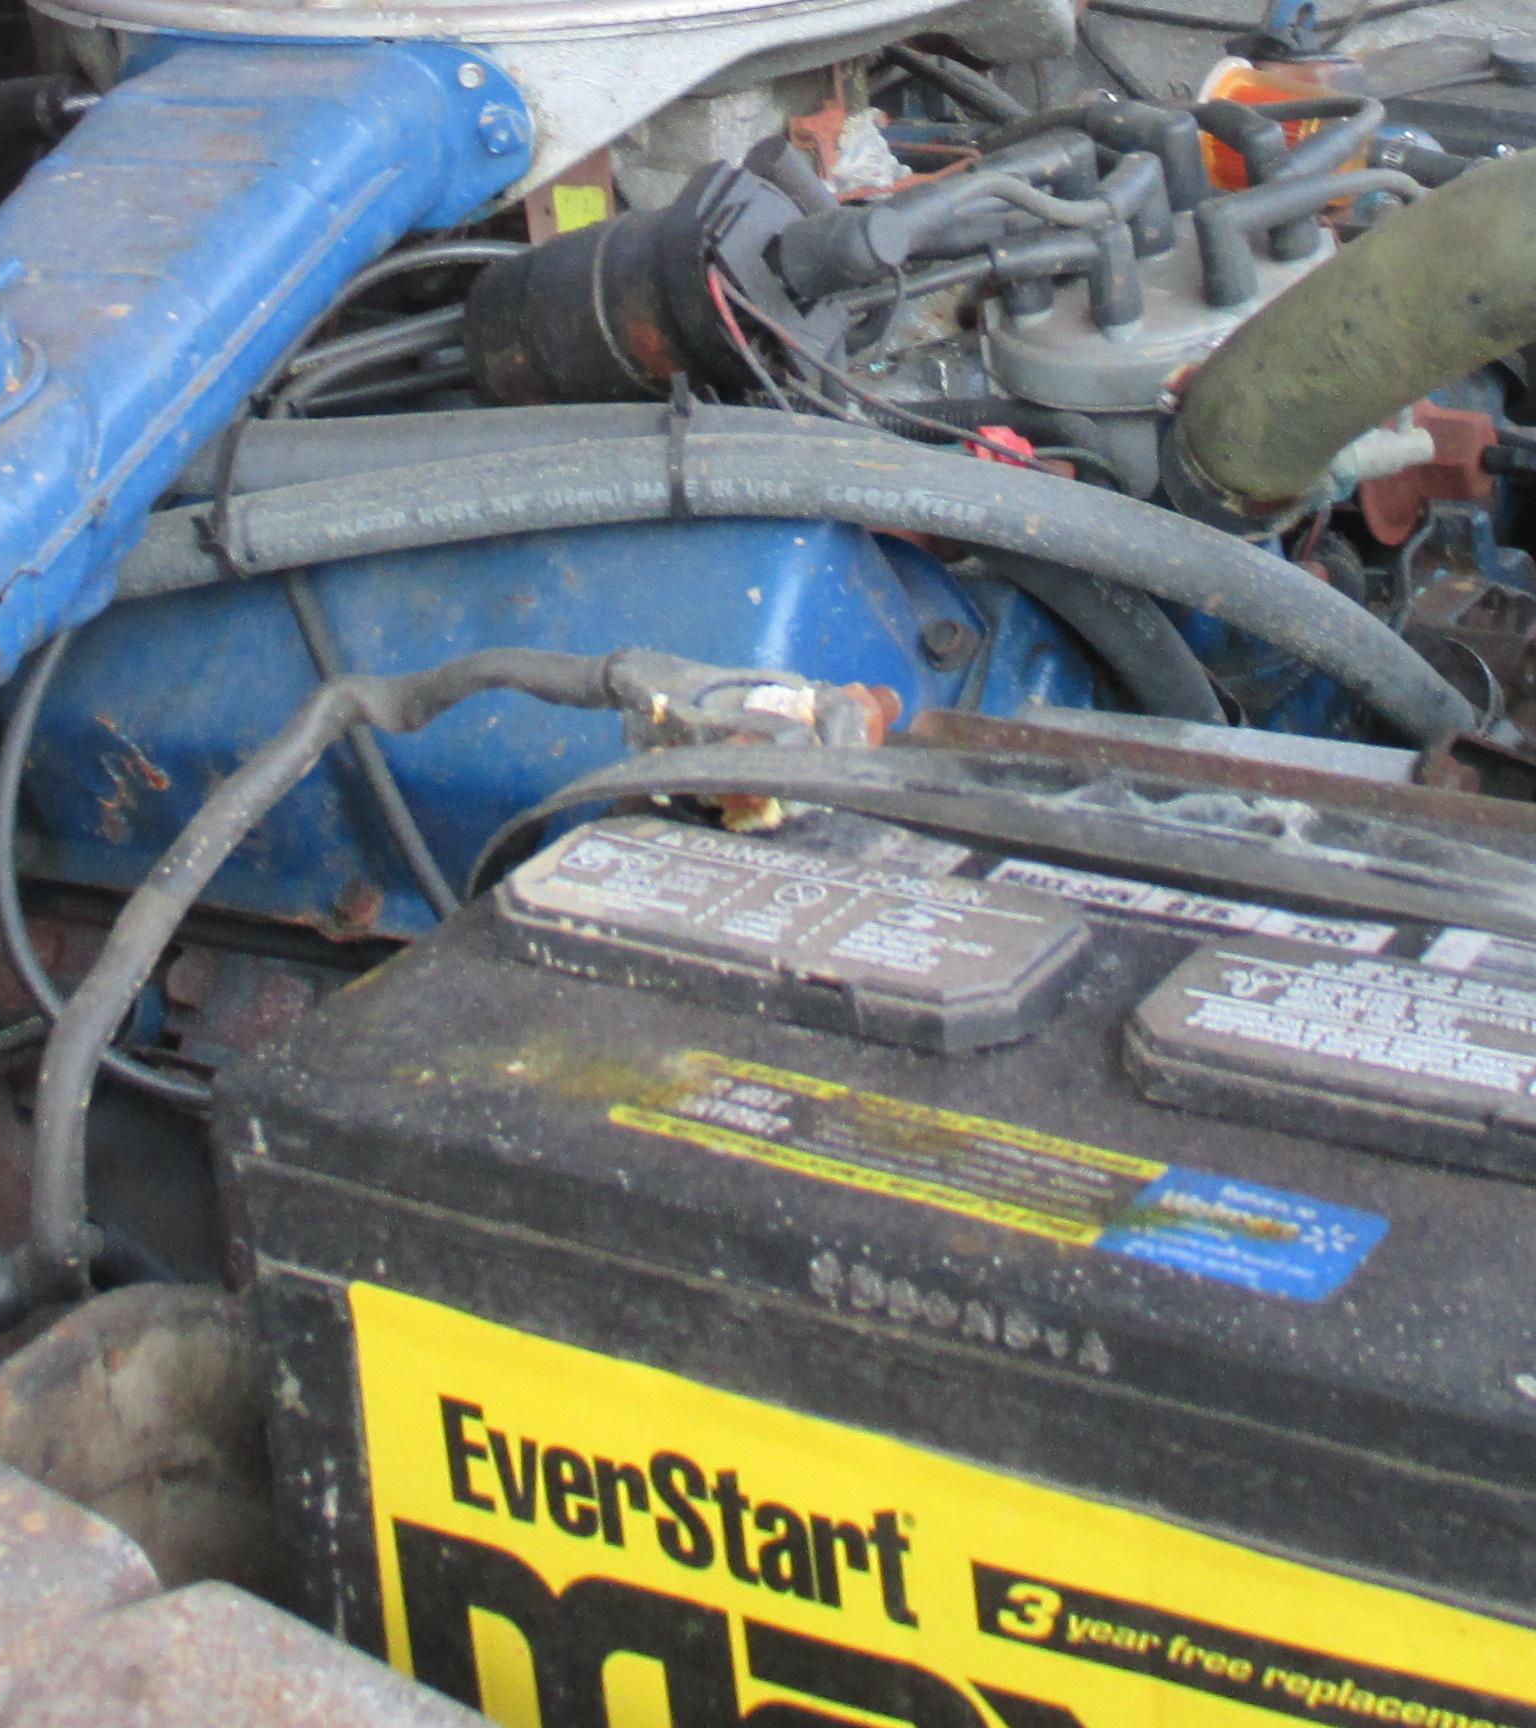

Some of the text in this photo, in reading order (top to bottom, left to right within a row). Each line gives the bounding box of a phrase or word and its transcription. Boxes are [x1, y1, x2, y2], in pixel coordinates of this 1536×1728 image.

[825, 483, 990, 523] GOODYEAR
[439, 1393, 920, 1630] EverStart
[996, 1581, 1063, 1643] 3
[1066, 1611, 1162, 1655] year
[1167, 1633, 1255, 1684] free
